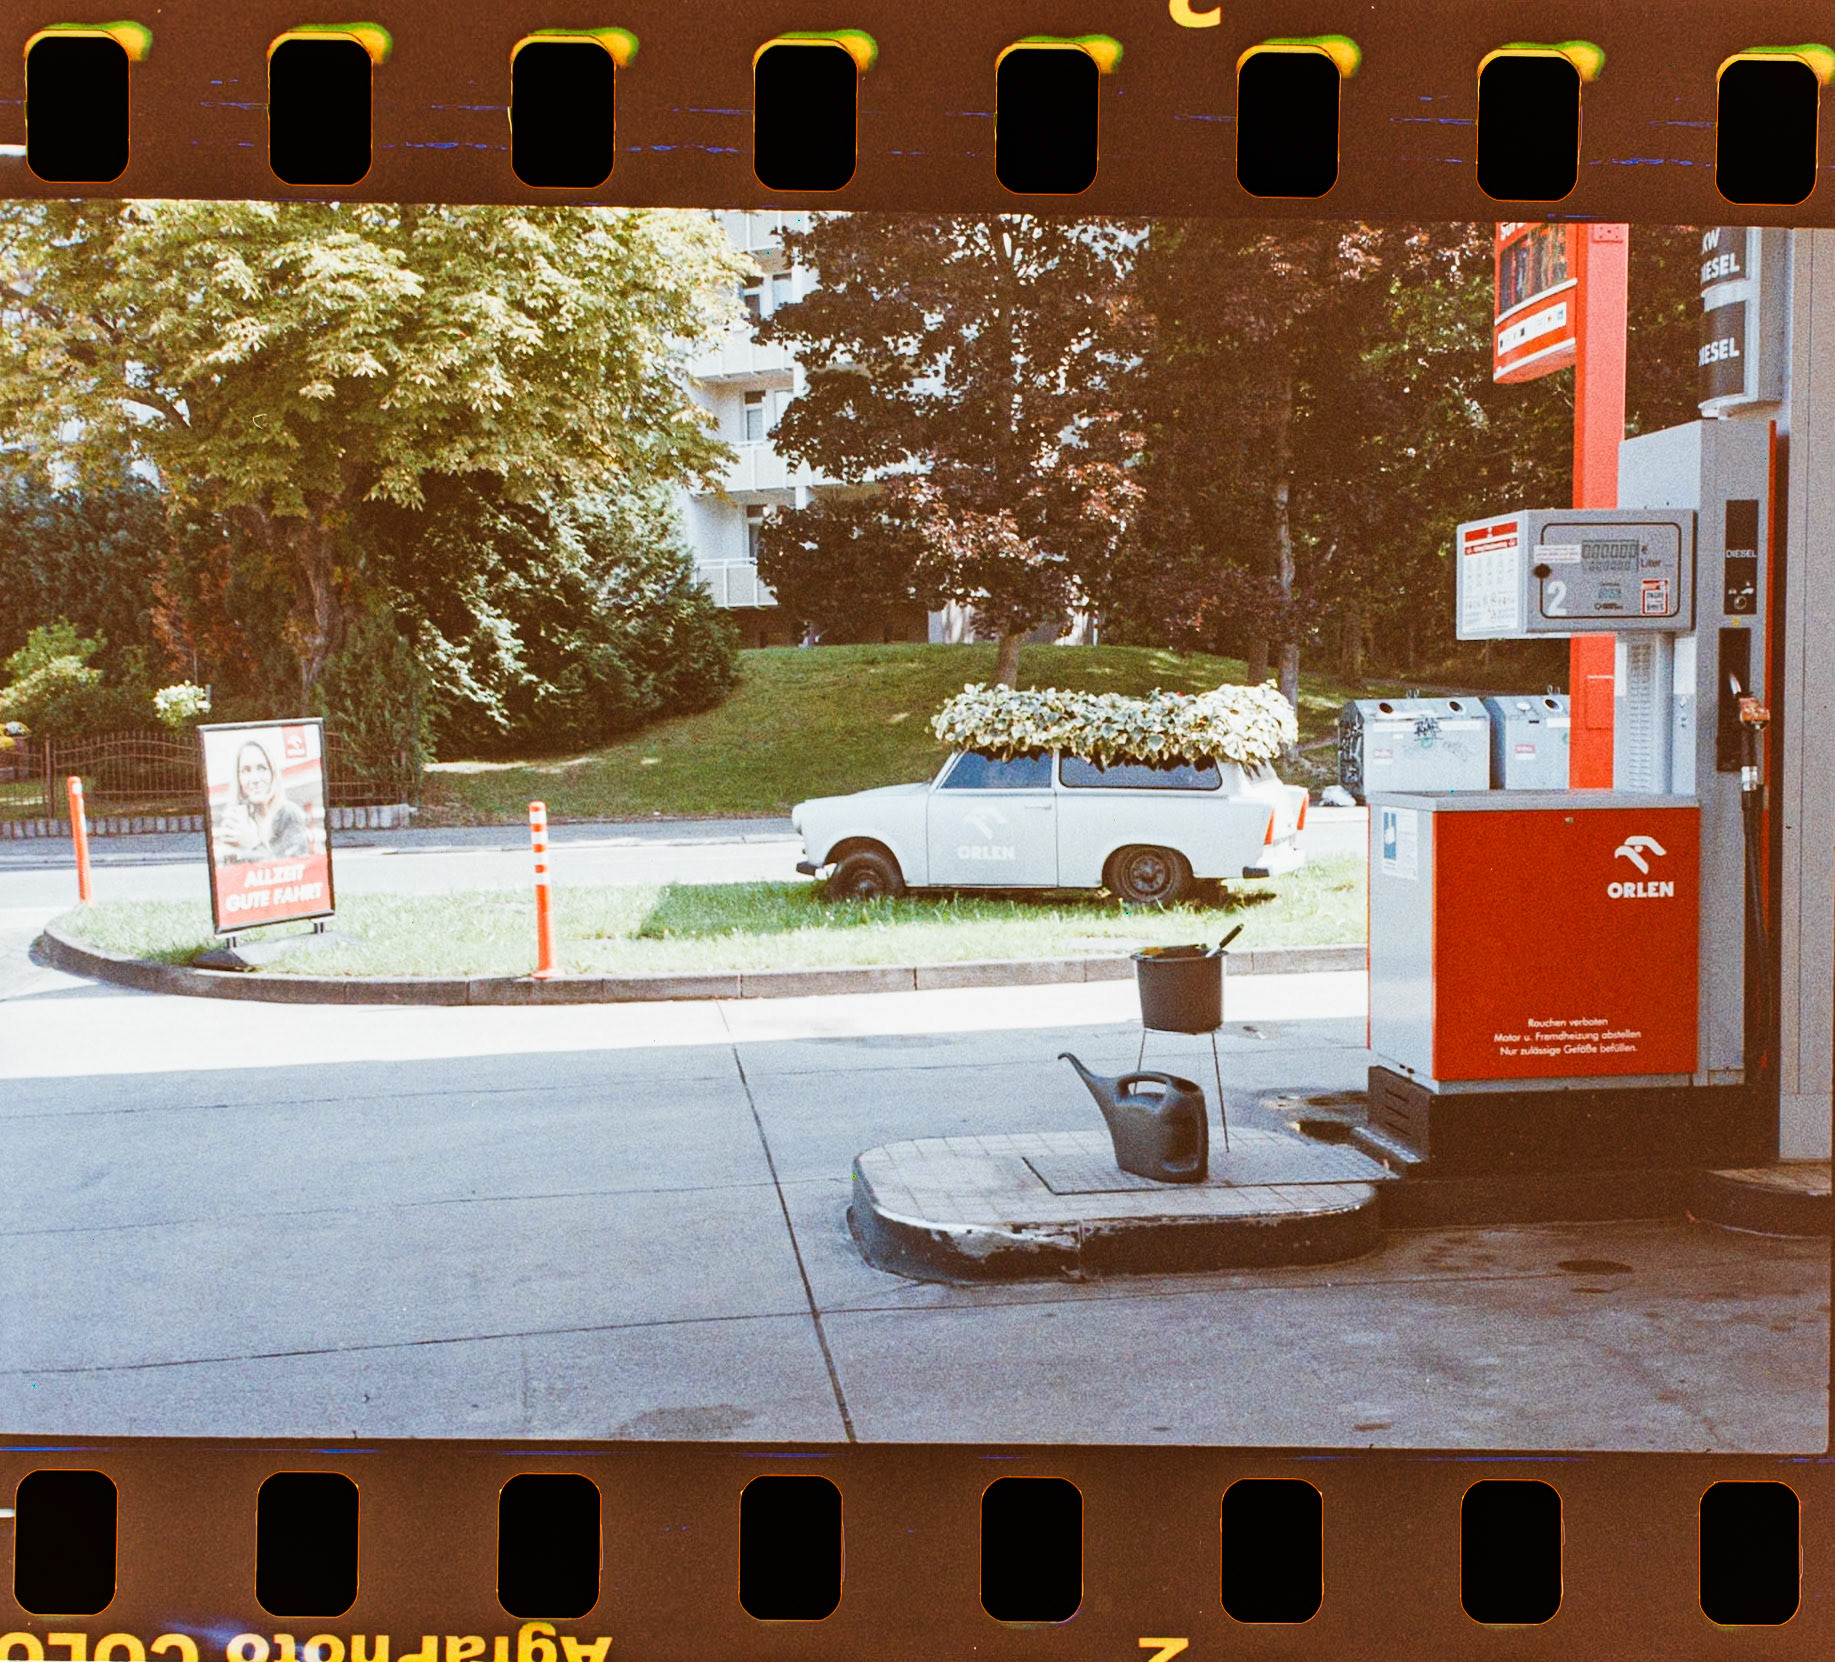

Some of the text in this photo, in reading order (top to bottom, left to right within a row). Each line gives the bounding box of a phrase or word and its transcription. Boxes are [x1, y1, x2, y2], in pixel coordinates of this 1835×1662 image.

[1725, 550, 1757, 558] DIESEL
[1547, 580, 1567, 617] 2
[957, 845, 1016, 860] ORLEN
[244, 864, 307, 888] ALLZEIT
[225, 882, 323, 912] GUTE FAHRT
[1607, 881, 1674, 899] ORLEN
[1528, 1017, 1608, 1028] Rauchen verboten
[1494, 1033, 1520, 1042] Motor
[1535, 1031, 1599, 1042] Fremdheizung
[1601, 1029, 1641, 1039] abstellen
[1500, 1046, 1517, 1055] Nur
[1520, 1045, 1561, 1056] zulässige
[1563, 1043, 1597, 1054] Gefäße
